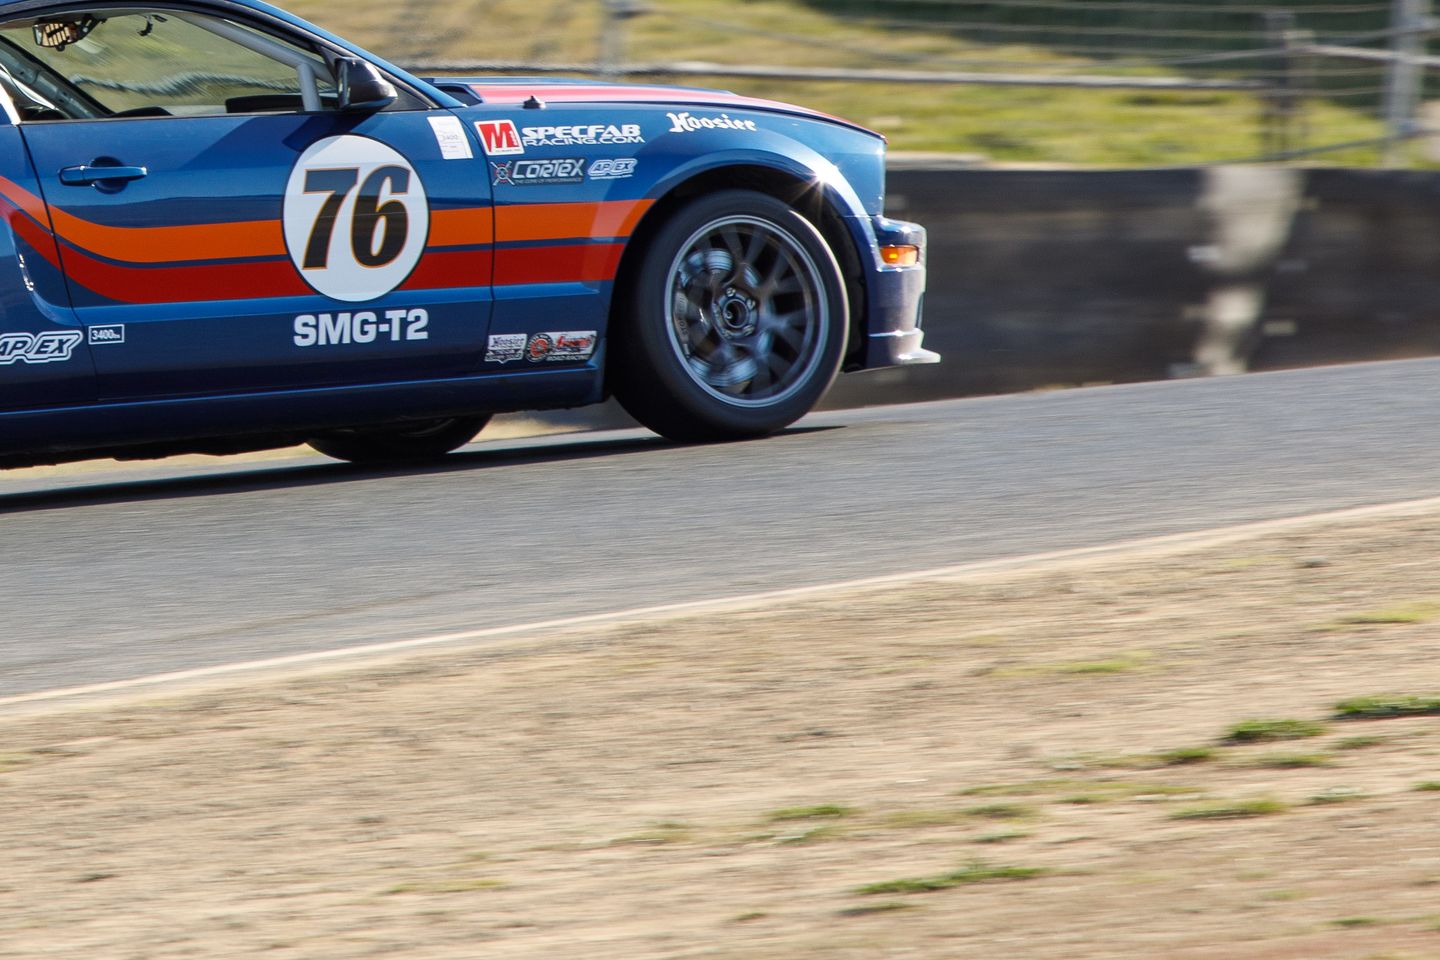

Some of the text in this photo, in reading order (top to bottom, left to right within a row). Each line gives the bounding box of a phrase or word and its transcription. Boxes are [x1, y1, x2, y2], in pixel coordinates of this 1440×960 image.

[521, 124, 641, 139] SPECFAB
[665, 112, 758, 133] Hoosier
[522, 135, 646, 147] RACING.COM
[589, 159, 635, 175] APEX
[302, 164, 411, 270] 76
[293, 308, 429, 347] SMG-T2
